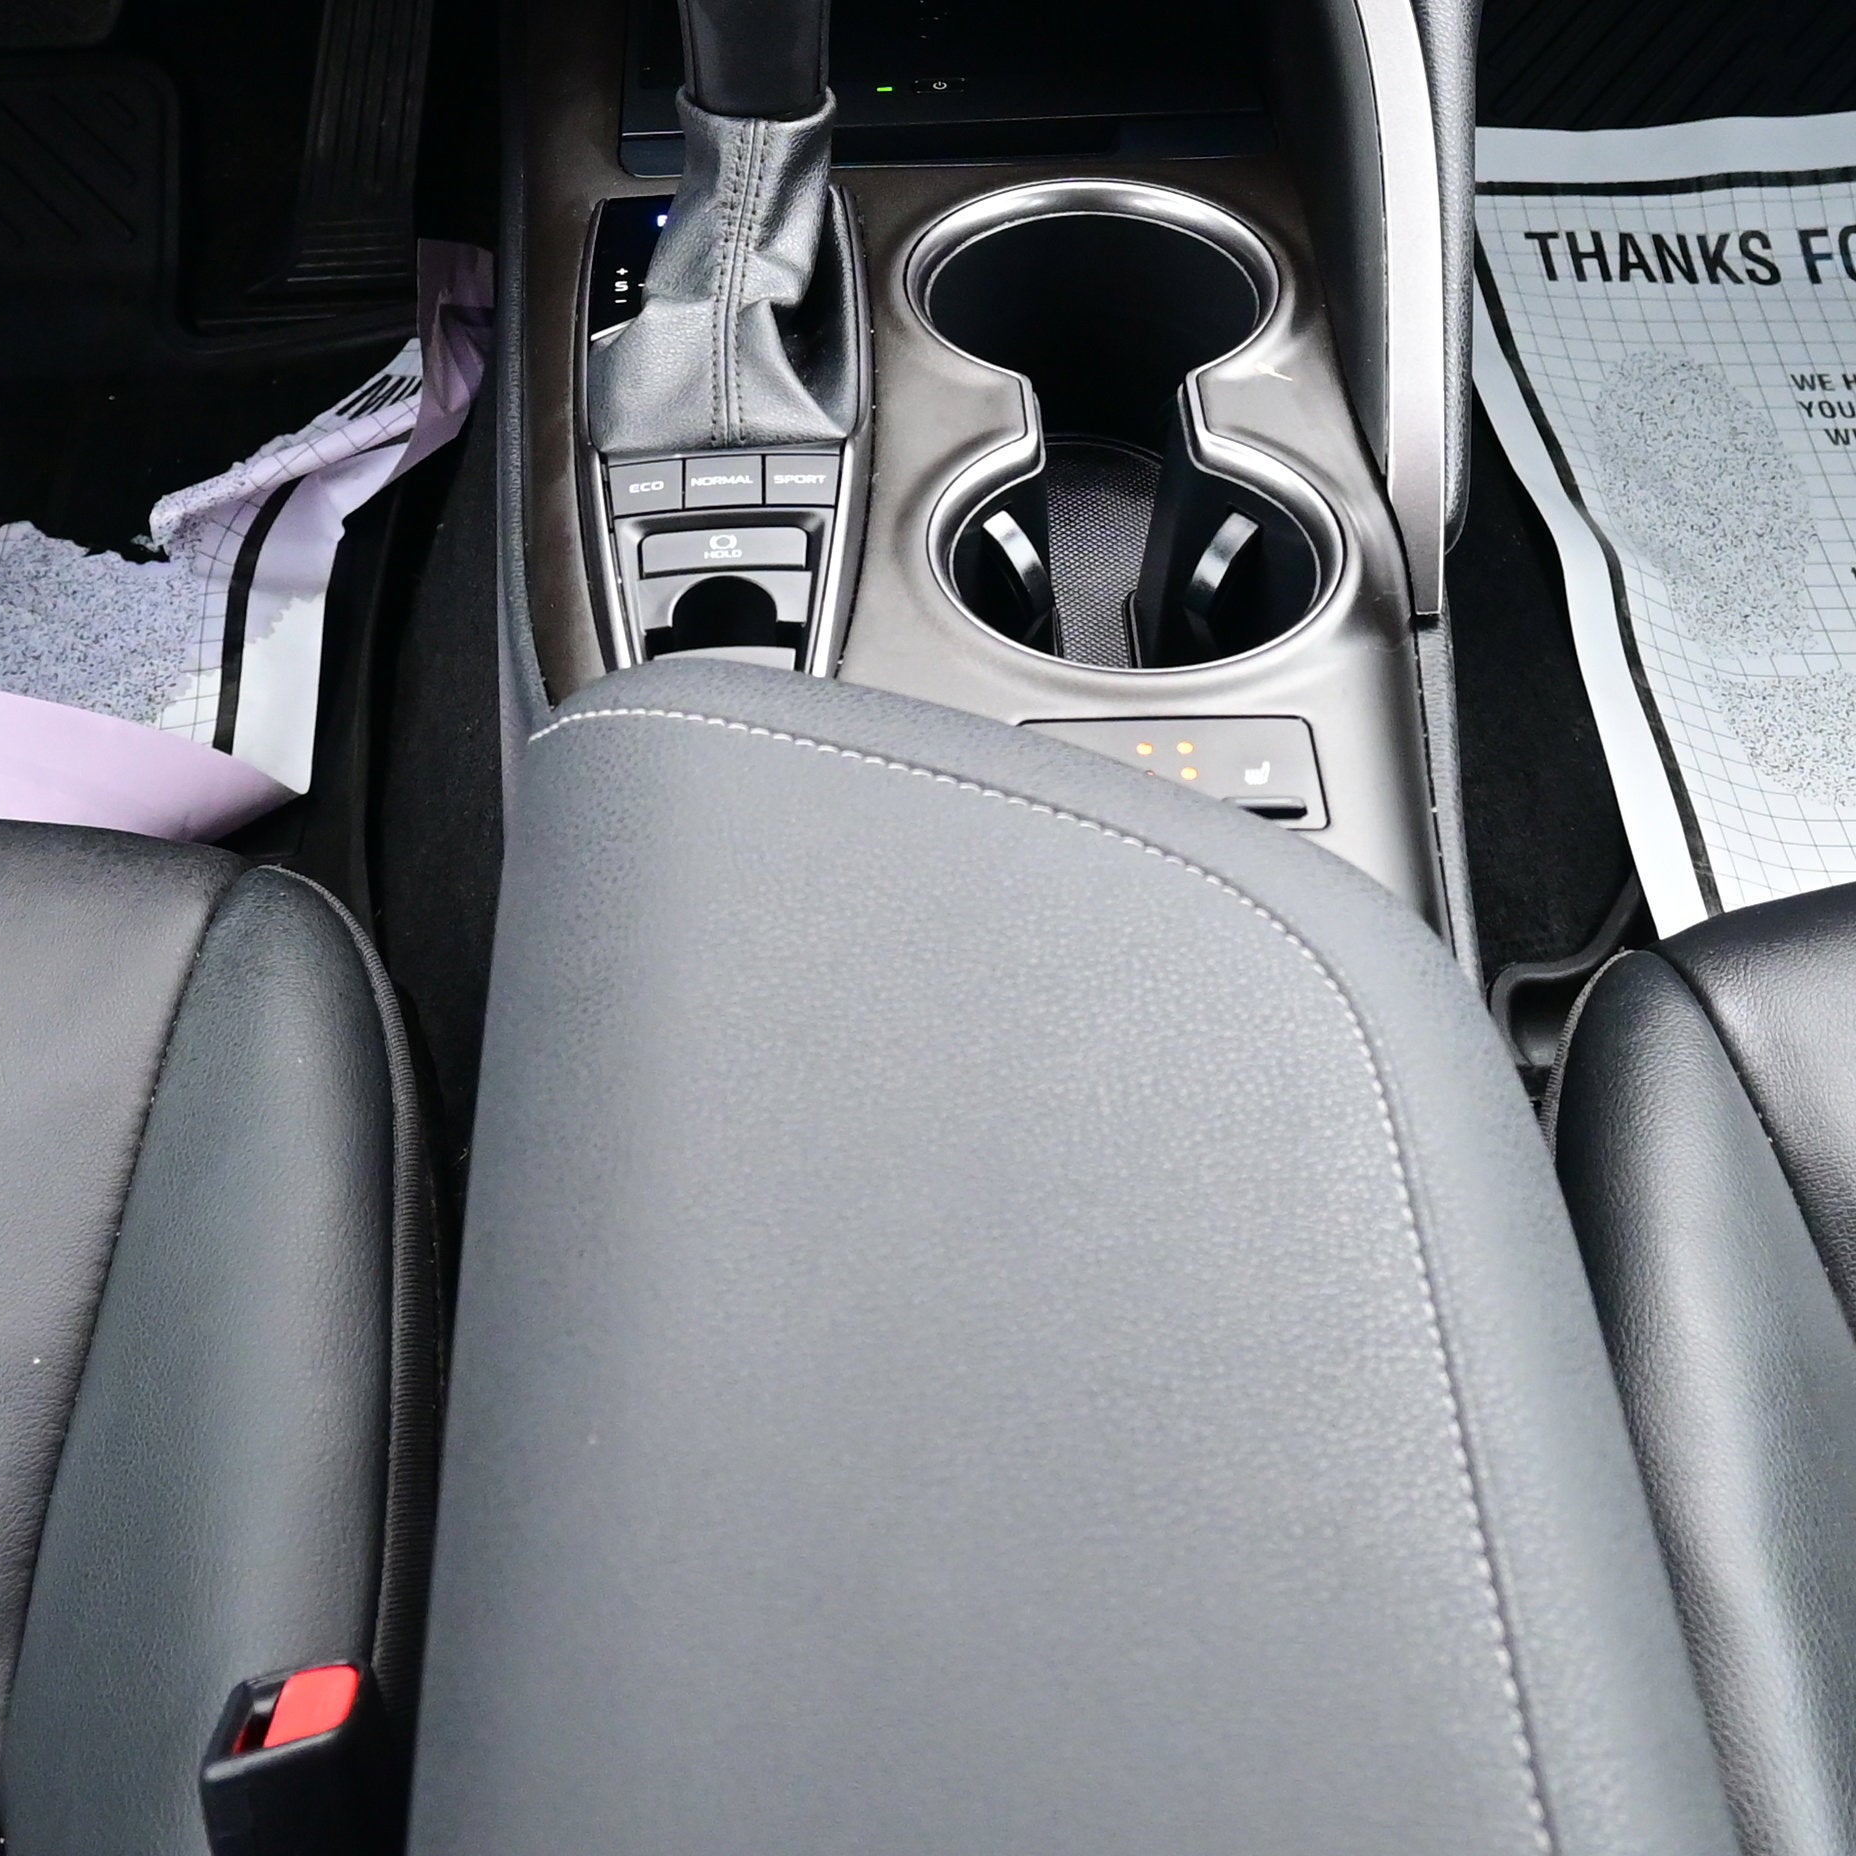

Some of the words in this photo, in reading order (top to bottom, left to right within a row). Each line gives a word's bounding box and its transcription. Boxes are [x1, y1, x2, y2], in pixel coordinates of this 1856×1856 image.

[1524, 229, 1781, 287] THANKS
[1791, 373, 1834, 391] WE
[691, 474, 754, 487] NORMAL
[774, 474, 827, 485] SPORT
[629, 481, 665, 493] ECO
[704, 549, 742, 560] HOLD
